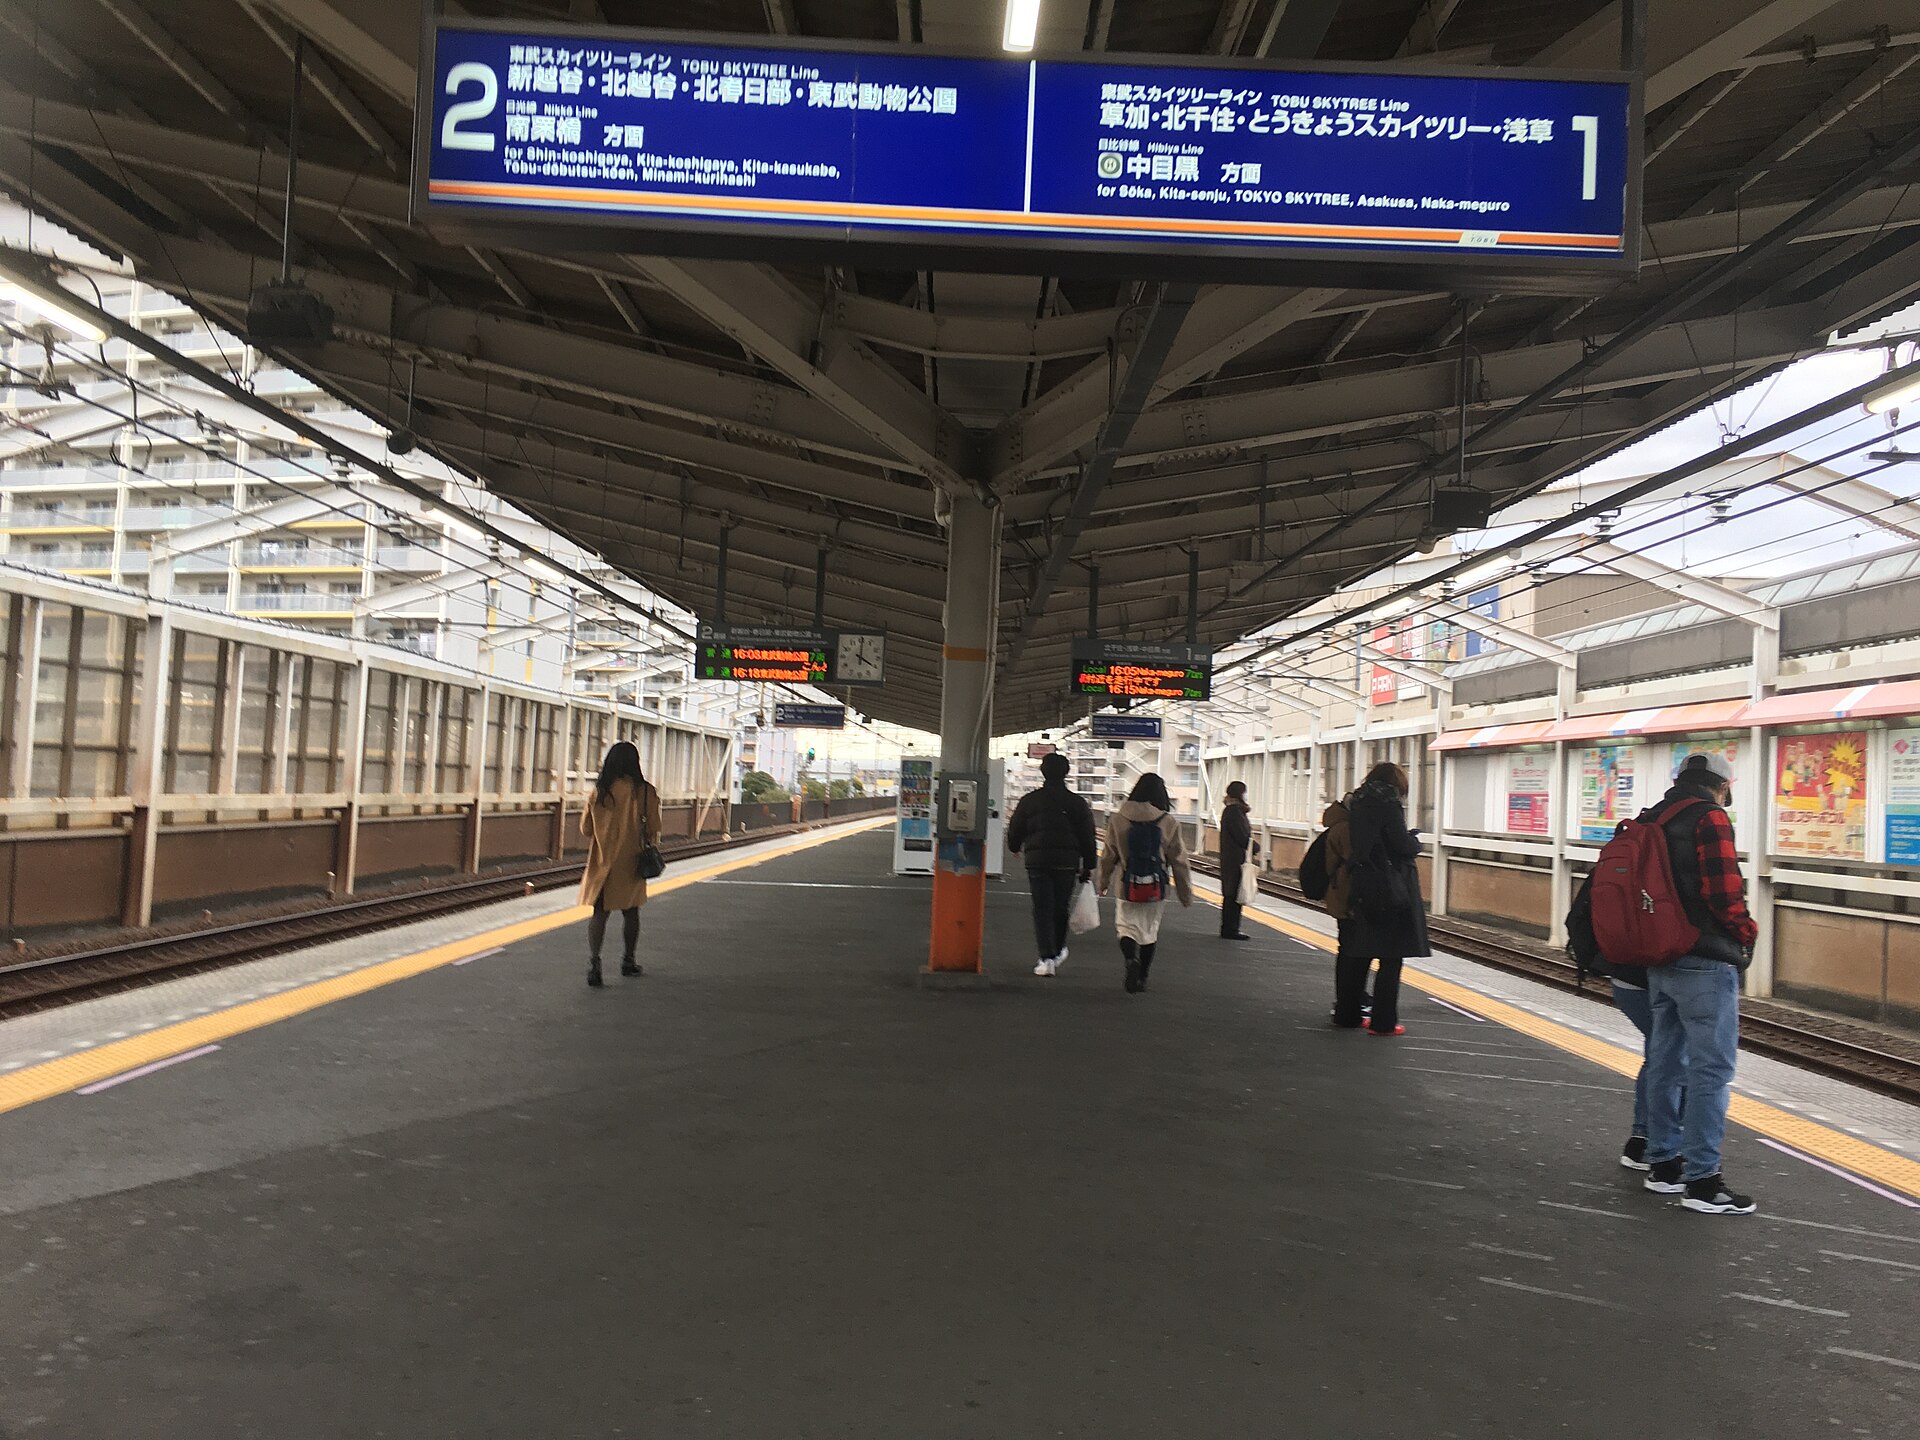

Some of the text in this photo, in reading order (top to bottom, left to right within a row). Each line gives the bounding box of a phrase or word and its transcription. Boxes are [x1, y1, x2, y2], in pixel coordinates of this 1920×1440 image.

[509, 45, 820, 80] 東武スカイツリーライン TOBU SKYTREE Line
[507, 64, 957, 115] 新越谷・北越谷・北春日部・東武動物公園
[1101, 82, 1410, 113] 東武スカイツリーライン TOBU SKYTREE Line
[442, 61, 498, 151] 2
[575, 105, 598, 119] Line
[505, 114, 644, 148] 南栗橋 方面
[1099, 101, 1555, 144] 草加・北千住・とうきょうスカイツリー・浅草
[504, 144, 841, 179] for Shin-koshigaya, Kita-koshigaya, Kita-kasukabe,
[1147, 141, 1180, 156] Hibiya
[1181, 143, 1205, 156] Line
[1572, 115, 1598, 200] 1
[642, 167, 757, 188] Minami-kurihashi
[1127, 153, 1262, 184] 中目黒 方面
[1097, 183, 1117, 198] for
[1159, 186, 1231, 204] Kita-senju,
[1234, 189, 1282, 205] TOKYO
[1285, 191, 1354, 208] SKYTREE,
[1357, 194, 1418, 211] Asakusa,
[1421, 196, 1510, 214] Naka-meguro
[701, 625, 713, 640] 2
[1186, 648, 1192, 660] 1
[1082, 665, 1107, 674] Local
[1110, 666, 1139, 675] 16:05
[1081, 684, 1106, 693] Local
[1109, 685, 1138, 695] 16:15
